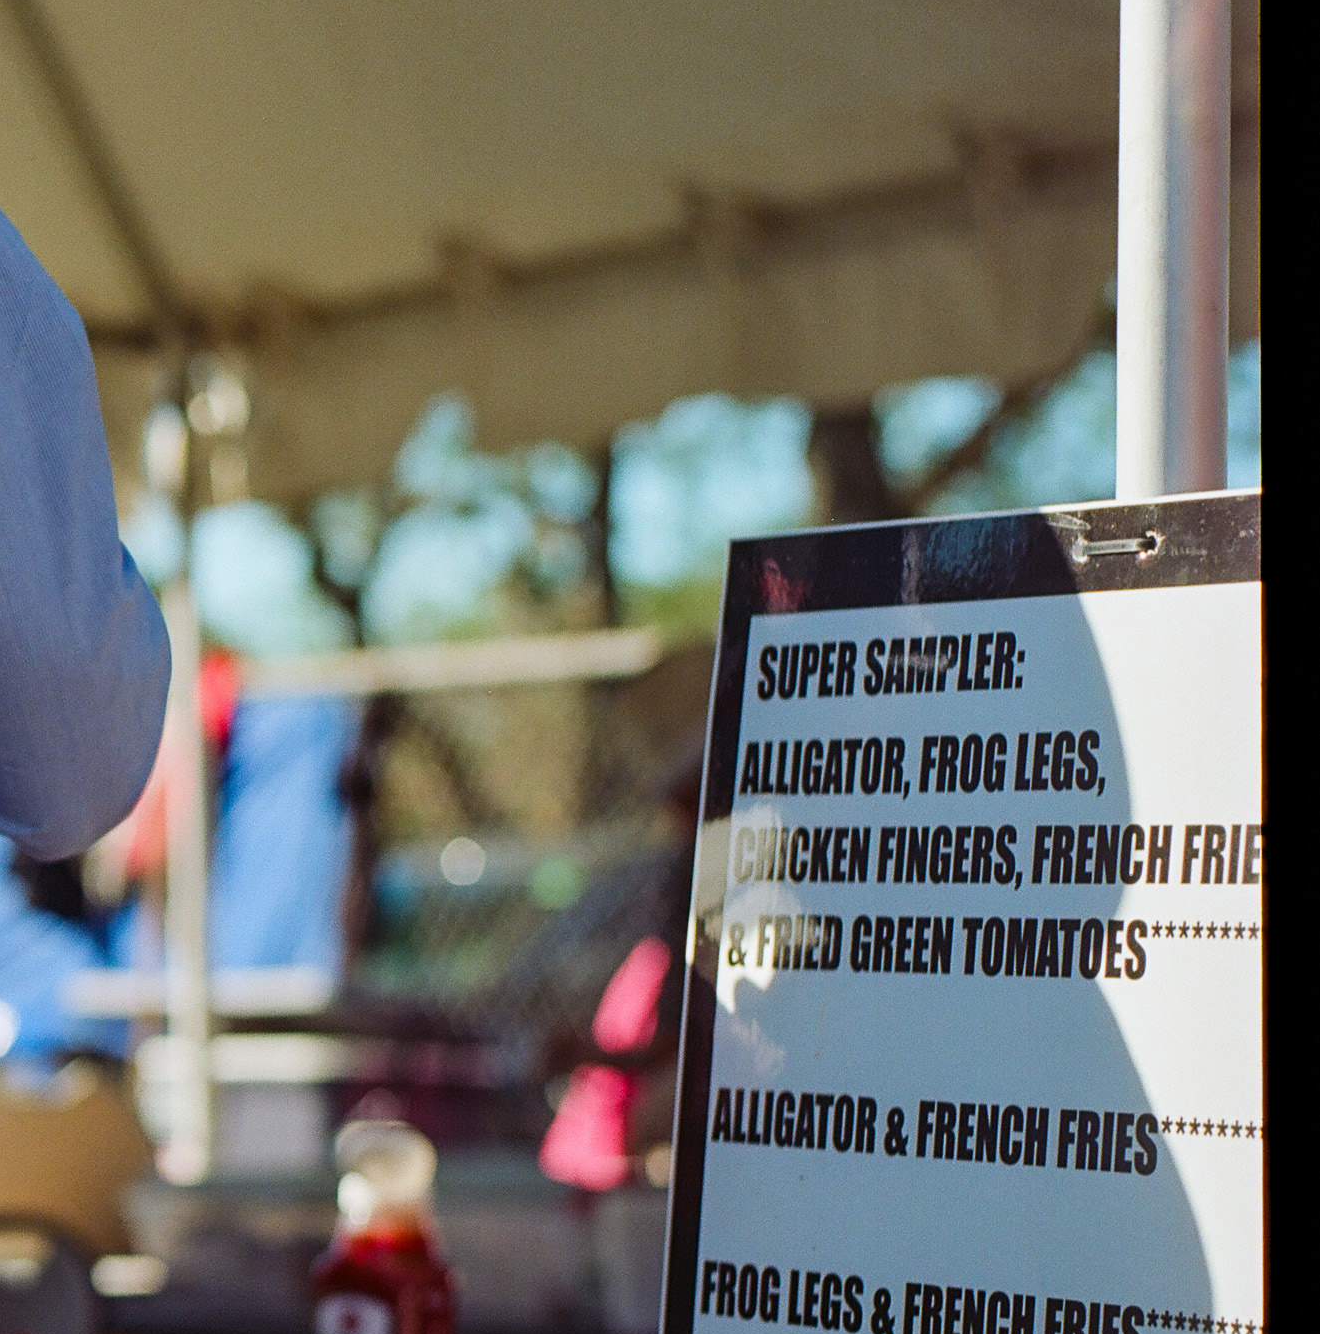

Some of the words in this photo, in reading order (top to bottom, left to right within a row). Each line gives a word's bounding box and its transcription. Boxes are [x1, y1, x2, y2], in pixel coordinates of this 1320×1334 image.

[757, 642, 857, 701] SUPER
[863, 631, 1027, 695] SAMPLER:
[739, 737, 910, 799] ALLIGATOR,
[918, 734, 1008, 794] FROG
[1014, 729, 1106, 795] LEGS,
[733, 827, 870, 885] CHICKEN
[877, 826, 1023, 889] FINGERS,
[1032, 825, 1173, 885] FRENCH
[727, 926, 747, 966] &
[755, 915, 843, 971] FRIED
[850, 917, 953, 974] GREEN
[962, 918, 1148, 980] TOMATOES
[711, 1088, 877, 1154] ALLIGATOR
[883, 1106, 908, 1156] &
[915, 1100, 1049, 1168] FRENCH
[1057, 1109, 1160, 1176] FRIES
[701, 1261, 781, 1323] FROG
[787, 1269, 864, 1333] LEGS
